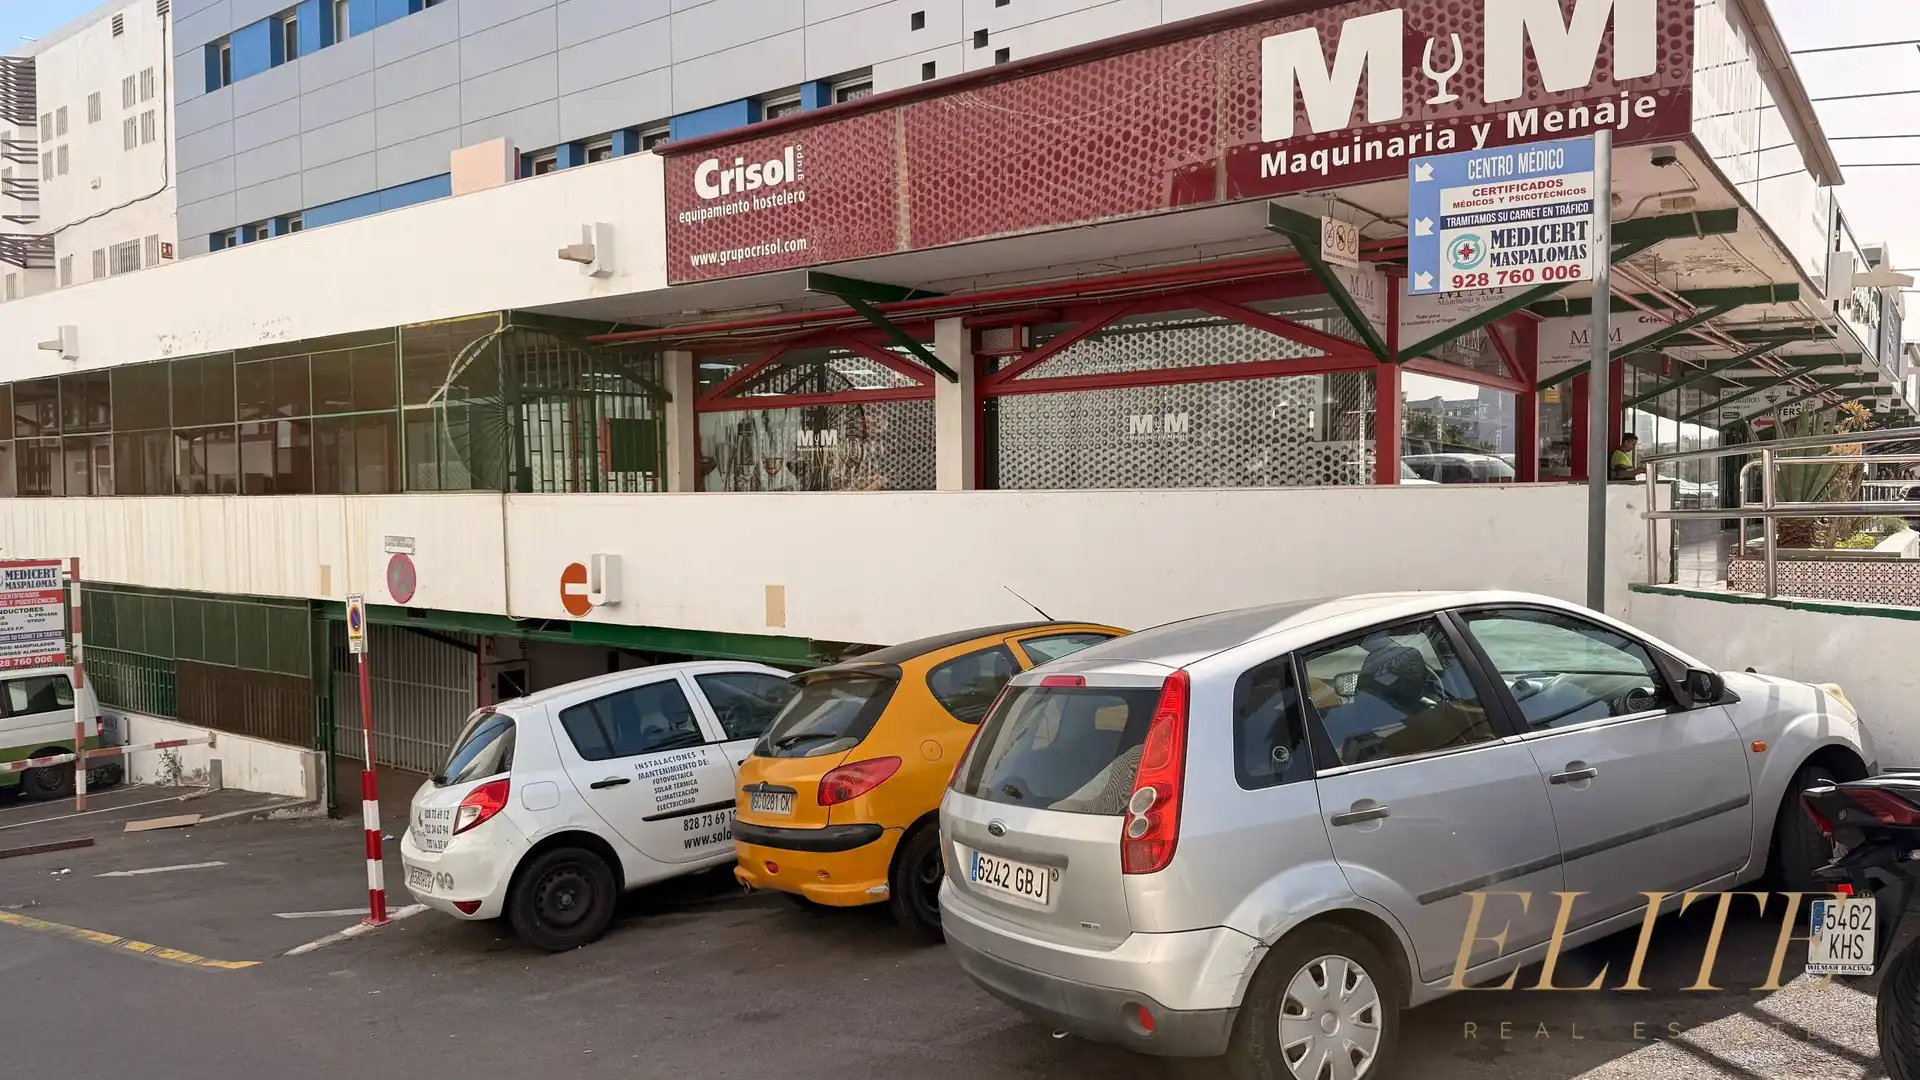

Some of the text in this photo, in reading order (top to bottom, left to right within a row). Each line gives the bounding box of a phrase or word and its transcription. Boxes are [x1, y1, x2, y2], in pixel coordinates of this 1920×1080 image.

[1261, 91, 1656, 178] Maquinaria y Menaje
[694, 146, 795, 200] Crisol
[796, 144, 805, 181] grupo
[1467, 148, 1564, 180] CENTRO MÉDICO
[1452, 187, 1587, 209] MÉDICOS Y PSICOTÉCNICOS
[1472, 178, 1564, 197] CERTIFICADOS
[679, 189, 806, 226] equipamiento hostelero
[1446, 202, 1589, 228] TRAMITAMOS SU CARNET EN TRÁFICO
[1490, 220, 1589, 249] MEDICERT
[690, 237, 807, 267] www.grupocrisol.com
[1489, 244, 1587, 268] MASPALOMAS
[1452, 264, 1582, 289] 928 760 006
[5, 568, 57, 580] MEDICERT
[5, 579, 57, 590] MASPALOMAS
[0, 607, 44, 615] NDUCTORES
[13, 657, 31, 665] 760
[35, 655, 53, 664] 006
[634, 751, 697, 771] INSTALACIONES
[638, 758, 710, 781] MANTENIMIENTO DE:
[652, 771, 694, 786] FOTOVOLTAICA
[654, 779, 698, 794] SOLAR TÉRMICA
[655, 787, 699, 803] CLIMATIZACIÓN
[656, 797, 696, 812] ELECTRICIDAD
[683, 818, 700, 832] 828
[702, 816, 713, 827] 73
[715, 812, 725, 825] 69
[978, 856, 1044, 899] 6242 GBJ
[1826, 904, 1872, 931] 5462
[1828, 933, 1864, 960] KHS
[1807, 964, 1839, 972] WILMAR
[1841, 964, 1872, 972] RACING
